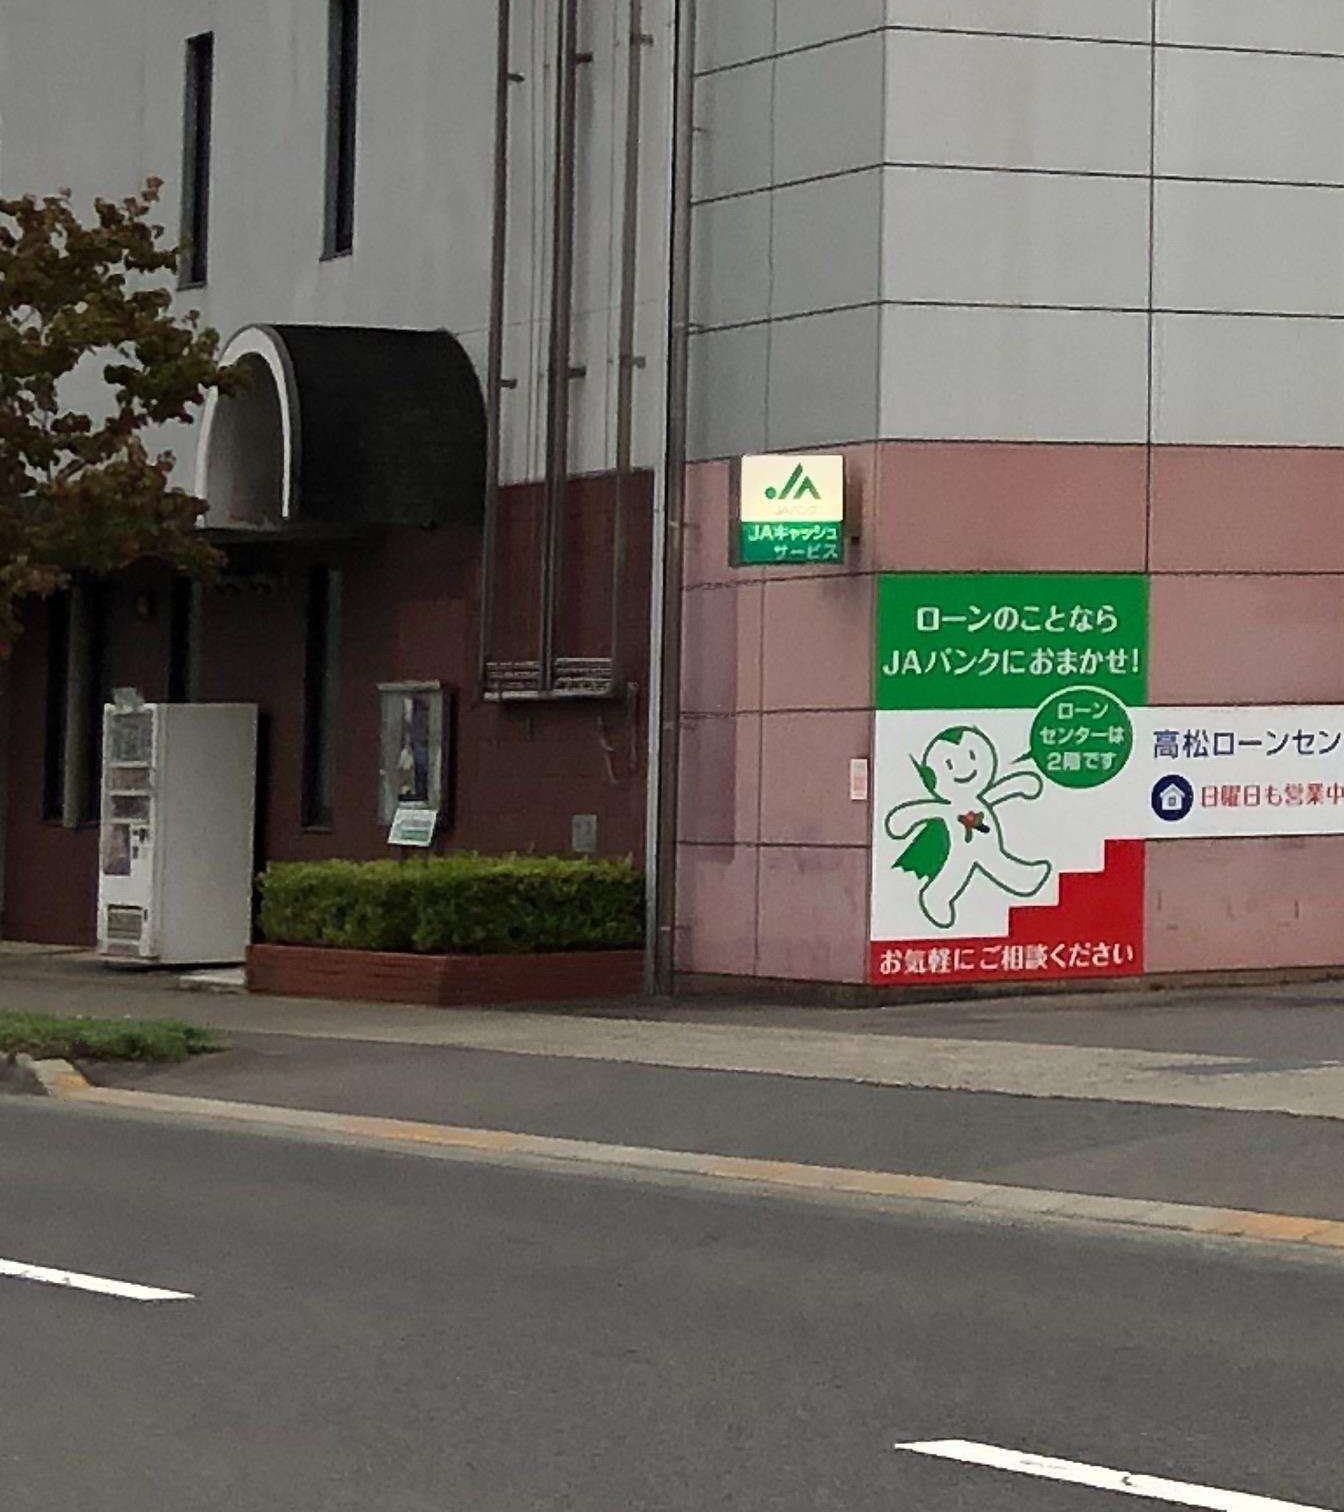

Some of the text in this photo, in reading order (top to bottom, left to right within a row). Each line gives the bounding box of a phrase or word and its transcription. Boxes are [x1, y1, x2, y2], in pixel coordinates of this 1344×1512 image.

[748, 524, 838, 542] JAキャッシュ
[774, 544, 839, 561] サービス
[917, 605, 1118, 632] ローンのことなら
[883, 648, 1139, 675] JAバンクにおまかせ!
[1057, 702, 1109, 720] ローン
[1039, 726, 1125, 744] センターは
[1047, 751, 1117, 772] 2階です
[879, 941, 1134, 975] お気軽にご相談ください
